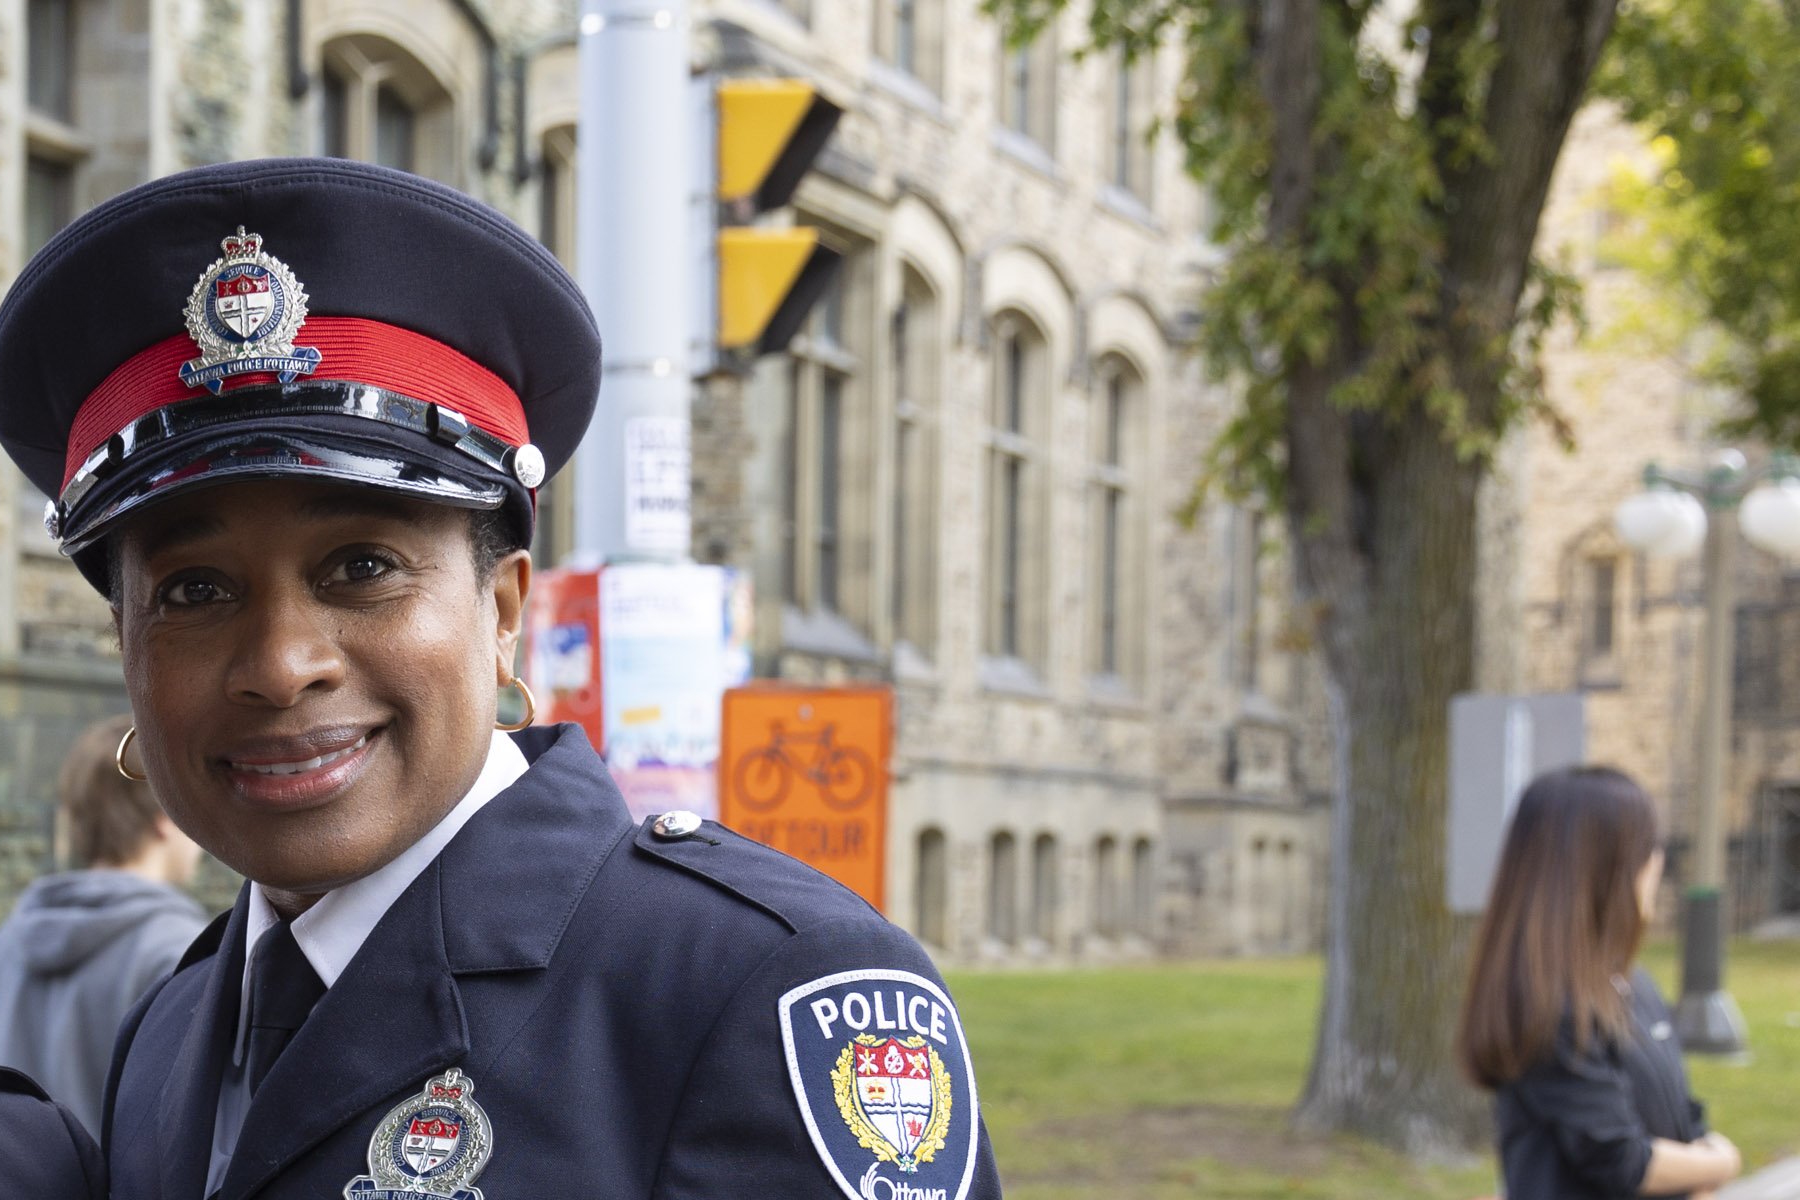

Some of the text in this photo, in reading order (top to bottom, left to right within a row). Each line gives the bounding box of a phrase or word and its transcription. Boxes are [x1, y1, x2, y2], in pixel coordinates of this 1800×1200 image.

[224, 265, 261, 278] SERVICE
[188, 357, 311, 385] OTTAWA POLICE D'OTTAWA
[810, 991, 948, 1045] POLICE
[421, 1107, 458, 1121] SERVICE
